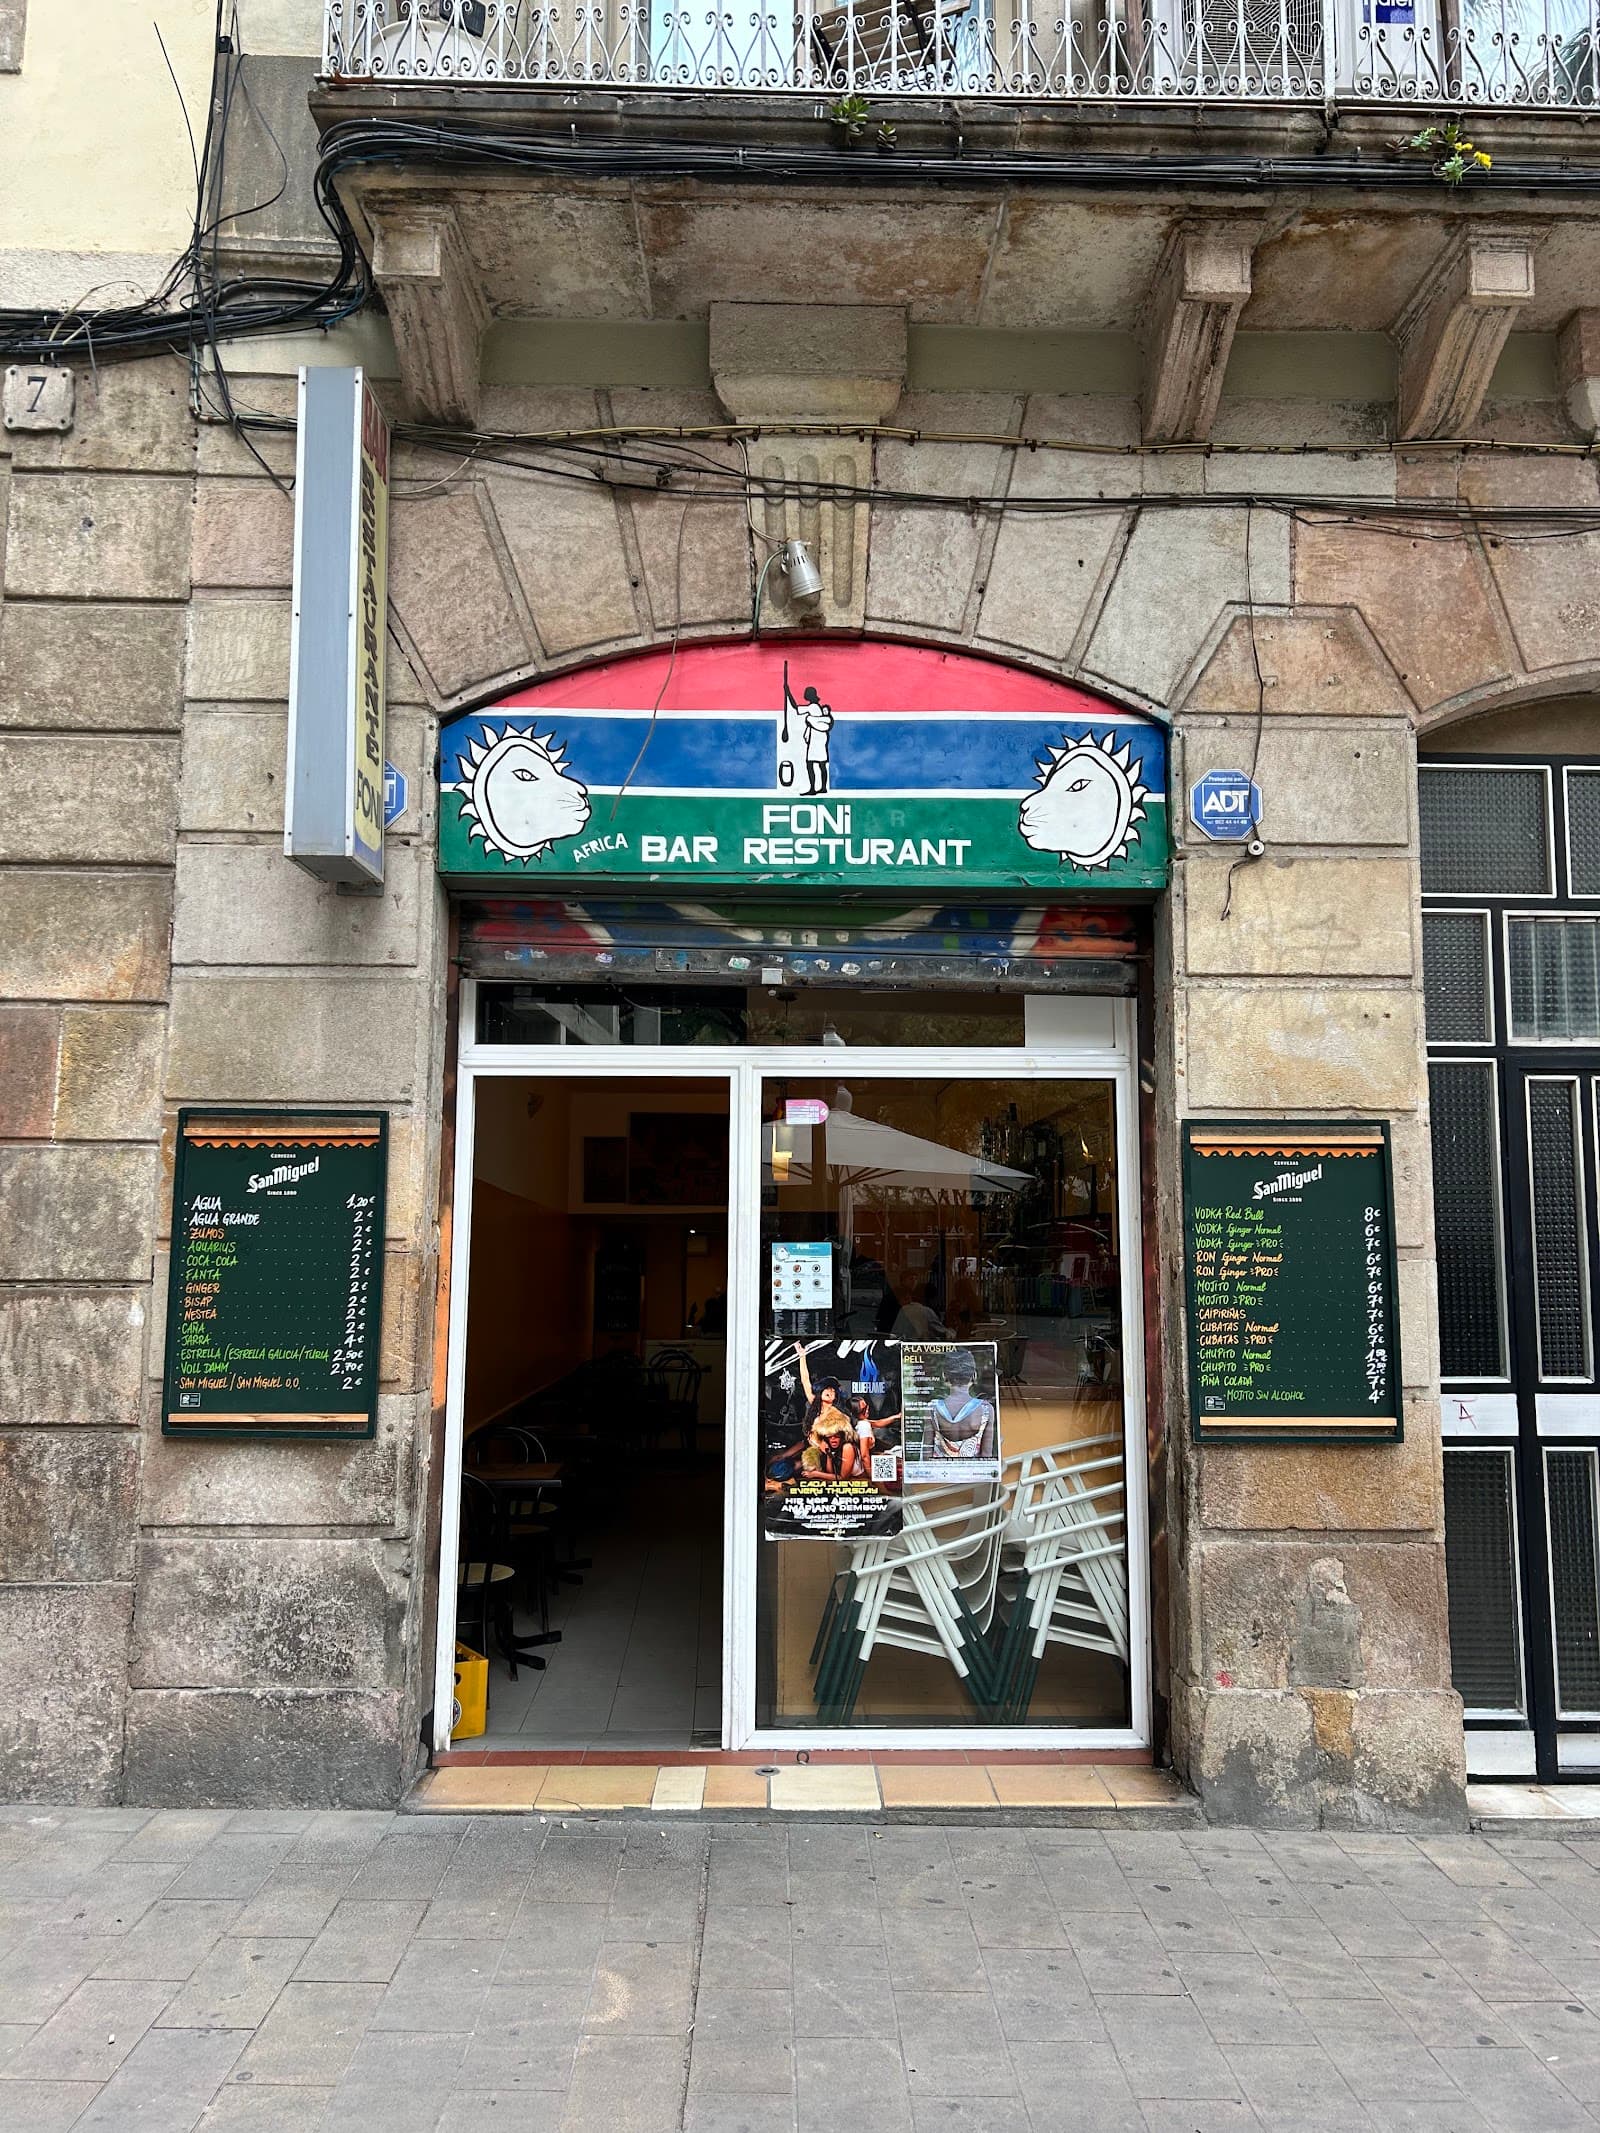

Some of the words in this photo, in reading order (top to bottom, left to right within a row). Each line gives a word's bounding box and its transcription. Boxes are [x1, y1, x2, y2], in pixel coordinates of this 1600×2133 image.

[27, 376, 47, 412] 7
[362, 388, 387, 485] BAR
[361, 458, 380, 766] RESTAURANTE
[1204, 790, 1249, 813] ADT
[572, 833, 628, 863] AFRICA
[641, 835, 718, 863] BAR
[743, 838, 972, 865] RESTURANT
[191, 1195, 222, 1211] AGUA
[189, 1212, 219, 1226] AGUA
[222, 1213, 260, 1226] GRANDE
[1194, 1207, 1223, 1220] VODKA
[1225, 1206, 1242, 1219] Red
[1244, 1207, 1264, 1220] Bull
[190, 1227, 225, 1239] ZUMOS
[1195, 1222, 1223, 1235] VODKA
[1226, 1223, 1252, 1237] Ginger
[1254, 1223, 1282, 1234] Normal
[187, 1240, 237, 1253] AQUARIUS
[1195, 1237, 1223, 1249] VODKA
[1227, 1239, 1254, 1252] Ginger
[186, 1255, 239, 1267] COCA-COLA
[1195, 1250, 1216, 1263] RON
[1222, 1252, 1249, 1266] Ginger
[1252, 1251, 1283, 1263] Normal
[185, 1269, 222, 1280] FANTA
[1196, 1265, 1214, 1277] RON
[1218, 1267, 1247, 1280] Ginger
[185, 1283, 220, 1294] GINGER
[1196, 1280, 1229, 1292] MOJITO
[1236, 1281, 1267, 1292] Normal
[184, 1296, 213, 1308] BISAP
[1197, 1294, 1229, 1306] MOJITO
[184, 1309, 218, 1321] NESTEA
[181, 1321, 205, 1334] CAÑA
[1200, 1321, 1239, 1333] CUBATAS
[1245, 1321, 1279, 1333] Normal
[182, 1334, 211, 1346] JARRA
[1200, 1335, 1239, 1346] CUBATAS
[181, 1348, 221, 1360] ESTRELLA
[924, 1345, 957, 1353] VOSTRA
[1242, 1348, 1272, 1360] Normal
[904, 1356, 924, 1364] PELL
[181, 1362, 201, 1374] VOLL
[204, 1362, 229, 1373] DAMM
[180, 1377, 195, 1389] SAN
[198, 1377, 228, 1389] MIGUEL
[236, 1376, 252, 1389] SAN
[253, 1376, 283, 1388] MIGUEL
[1224, 1375, 1254, 1387] COLADA
[852, 1381, 886, 1394] BLUEFLAME
[1226, 1389, 1255, 1401] MOJITO
[1270, 1390, 1306, 1401] ALCOHOL
